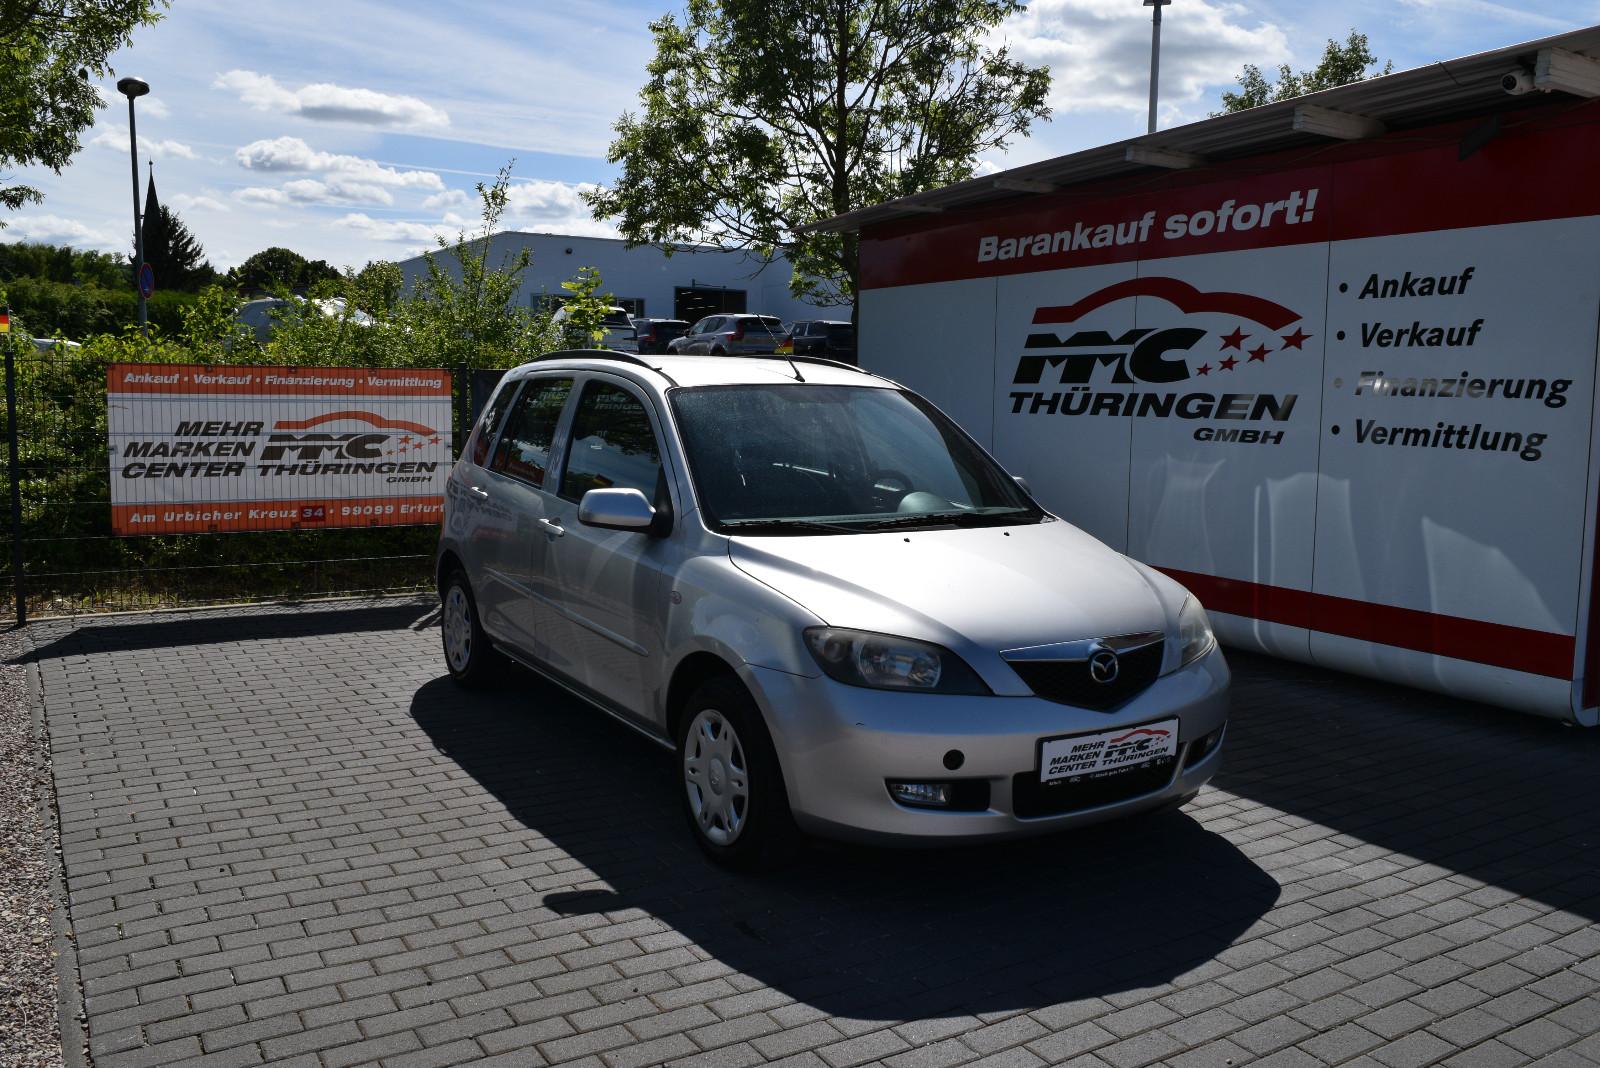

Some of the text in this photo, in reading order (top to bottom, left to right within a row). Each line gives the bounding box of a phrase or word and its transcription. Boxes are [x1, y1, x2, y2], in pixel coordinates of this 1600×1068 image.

[977, 188, 1319, 263] Barankauf sofort!
[1358, 266, 1476, 300] Ankauf
[1360, 318, 1485, 348] Verkauf
[123, 373, 443, 389] Ankauf Verkauf Finanzierung Vermittlung
[1355, 370, 1573, 409] Finanzierung
[1008, 386, 1298, 422] THÜRINGEN
[174, 420, 264, 437] MEHR
[1193, 427, 1285, 445] GMBH
[122, 441, 256, 458] MARKEN
[1355, 418, 1548, 462] Vermittlung
[121, 460, 438, 479] CENTER THÜRINGEN
[386, 476, 433, 485] GMBH
[130, 512, 156, 524] Am
[163, 509, 242, 522] Urbicher
[248, 508, 297, 519] Kreuz
[341, 505, 394, 516] 99099
[400, 503, 446, 515] Erfurt
[1071, 740, 1106, 754] MEHR
[1048, 760, 1097, 775] CENTER
[1102, 746, 1169, 766] THÜRINGEN
[1050, 750, 1102, 766] MARKEN
